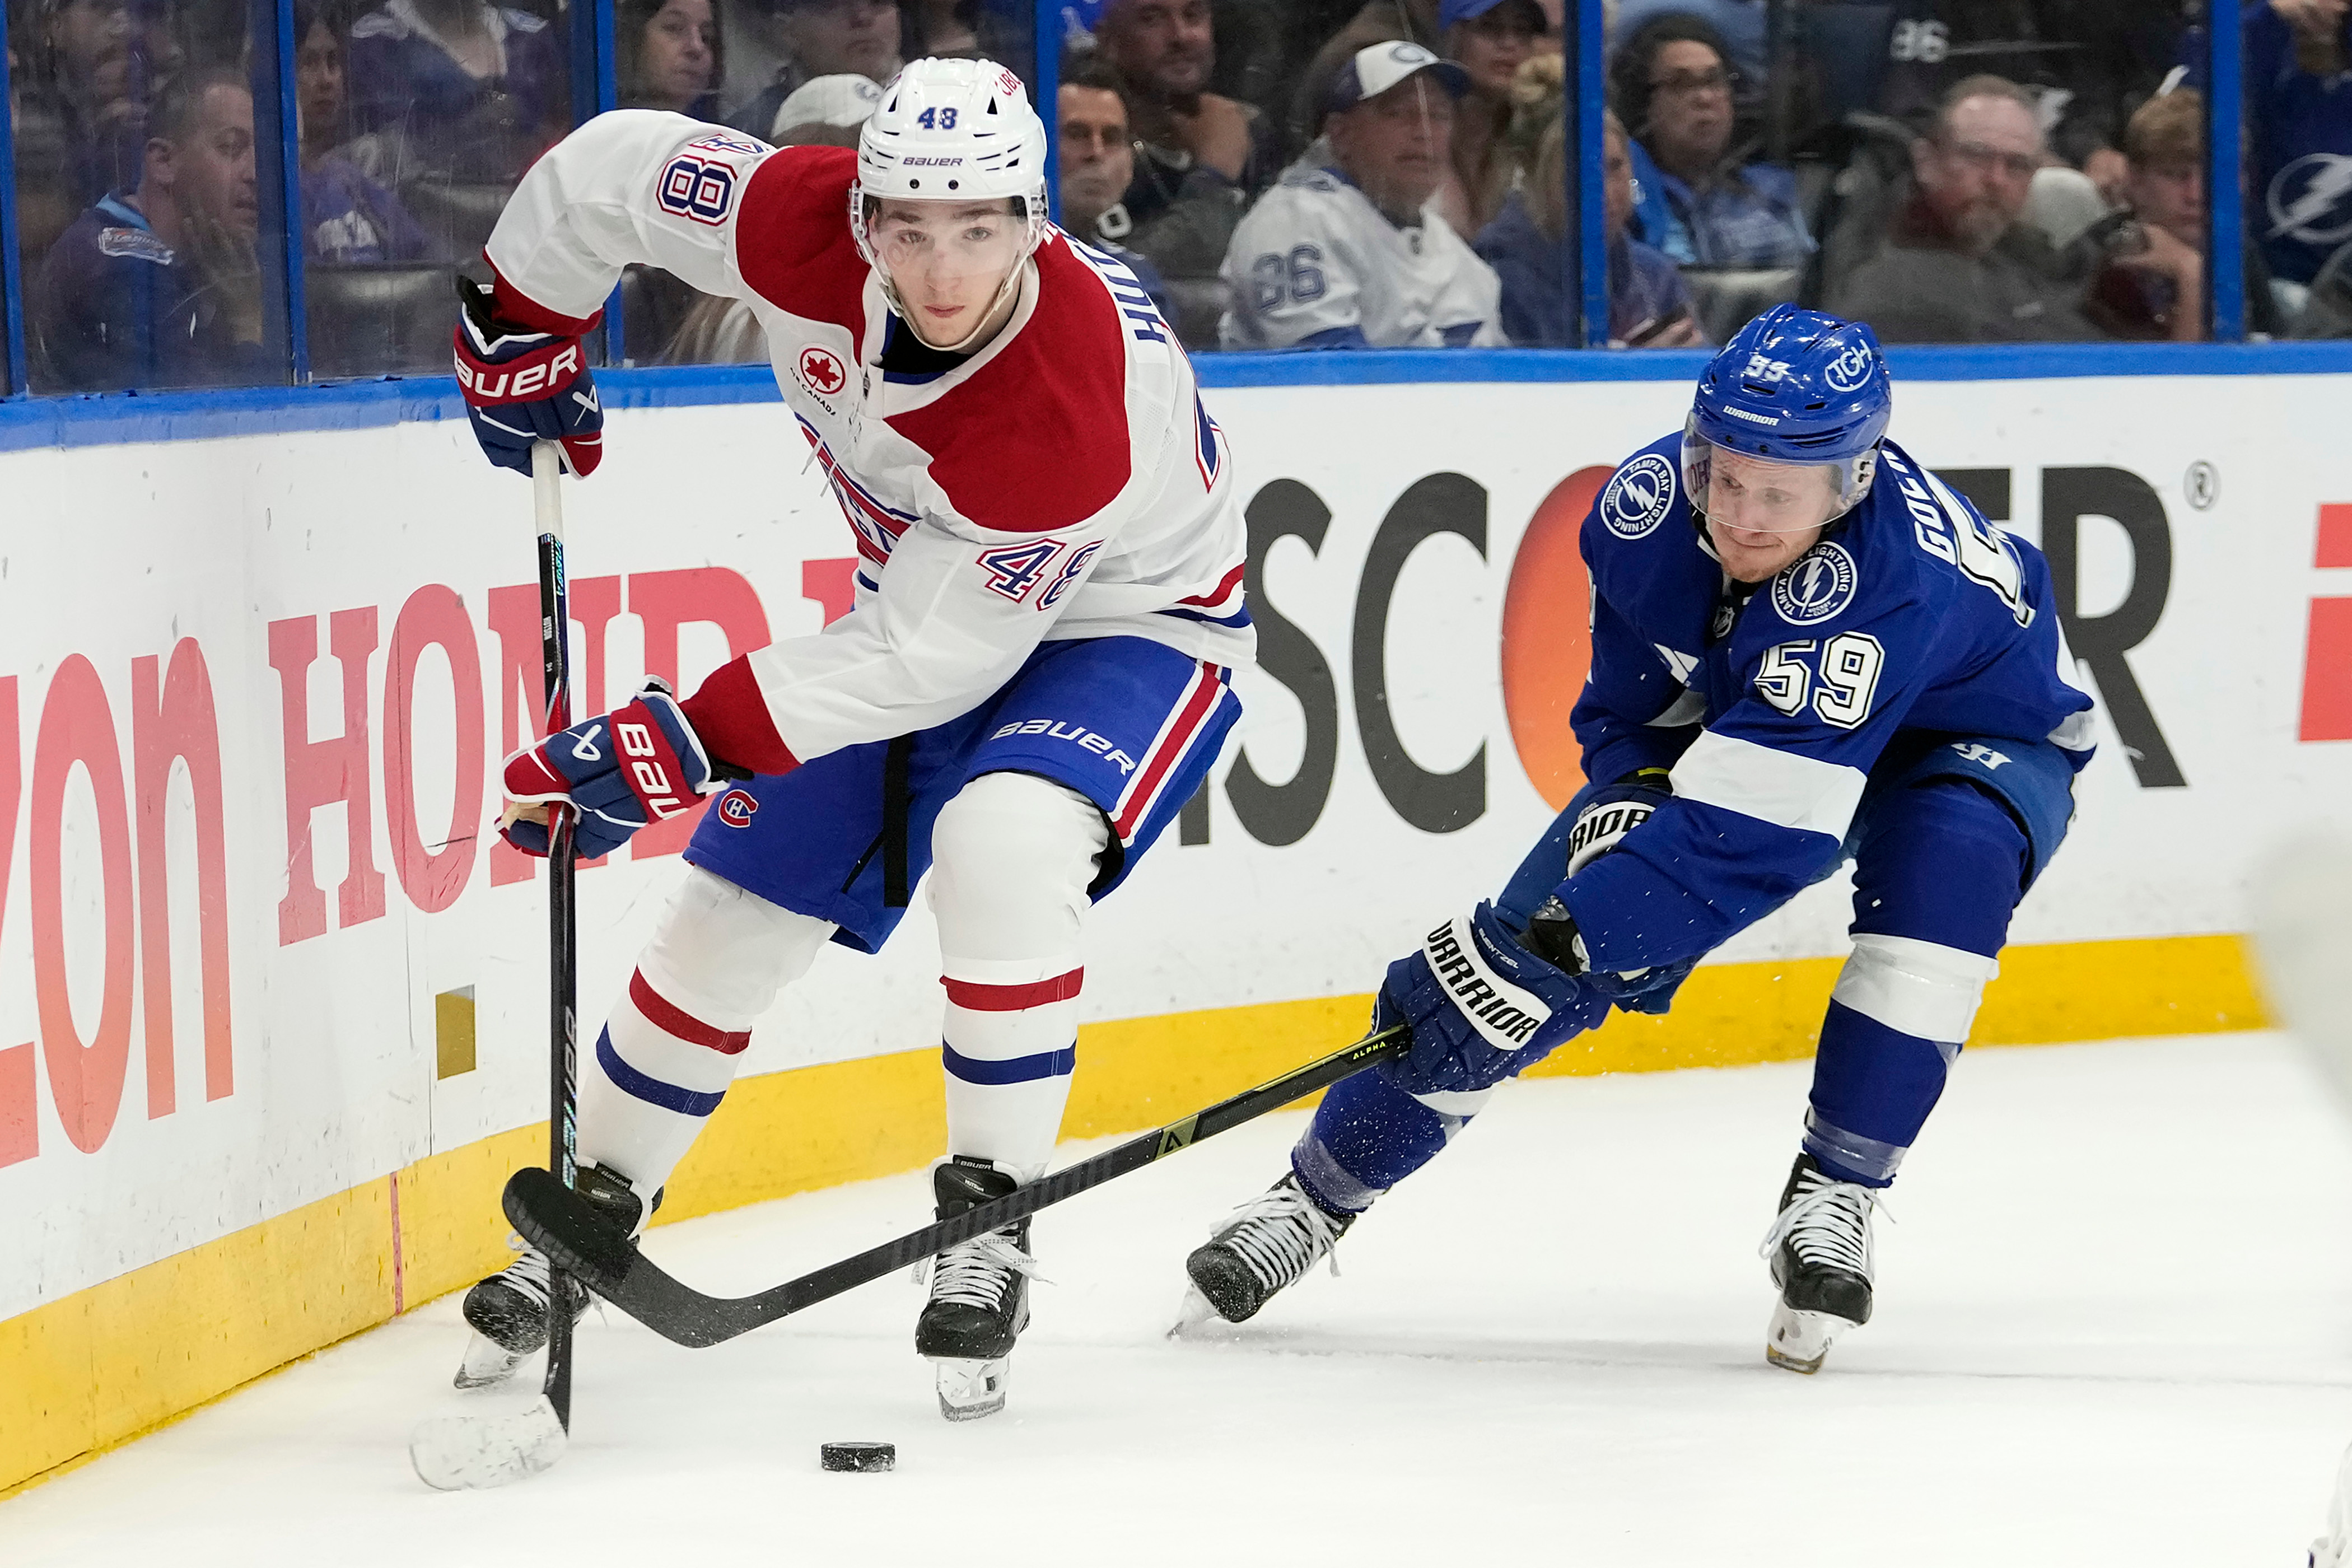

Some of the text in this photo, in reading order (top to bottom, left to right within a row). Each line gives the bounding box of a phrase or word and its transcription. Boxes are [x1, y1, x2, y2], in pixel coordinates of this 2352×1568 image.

[917, 107, 958, 130] 48
[903, 157, 963, 166] BAUER
[454, 344, 578, 398] AUER
[1746, 354, 1791, 382] 59
[1827, 338, 1873, 384] TGH
[1723, 404, 1780, 426] WARRIOR
[1613, 459, 1670, 533] TAMPA BAY LIGHTNING
[1808, 547, 1851, 592] LIGHTNING
[1776, 578, 1796, 615] TAMPA
[1753, 631, 1886, 730] 59
[268, 557, 858, 948] HOND
[988, 719, 1137, 776] BAUER
[1568, 809, 1653, 862] RIOR
[1352, 1041, 1386, 1060] ALPHA
